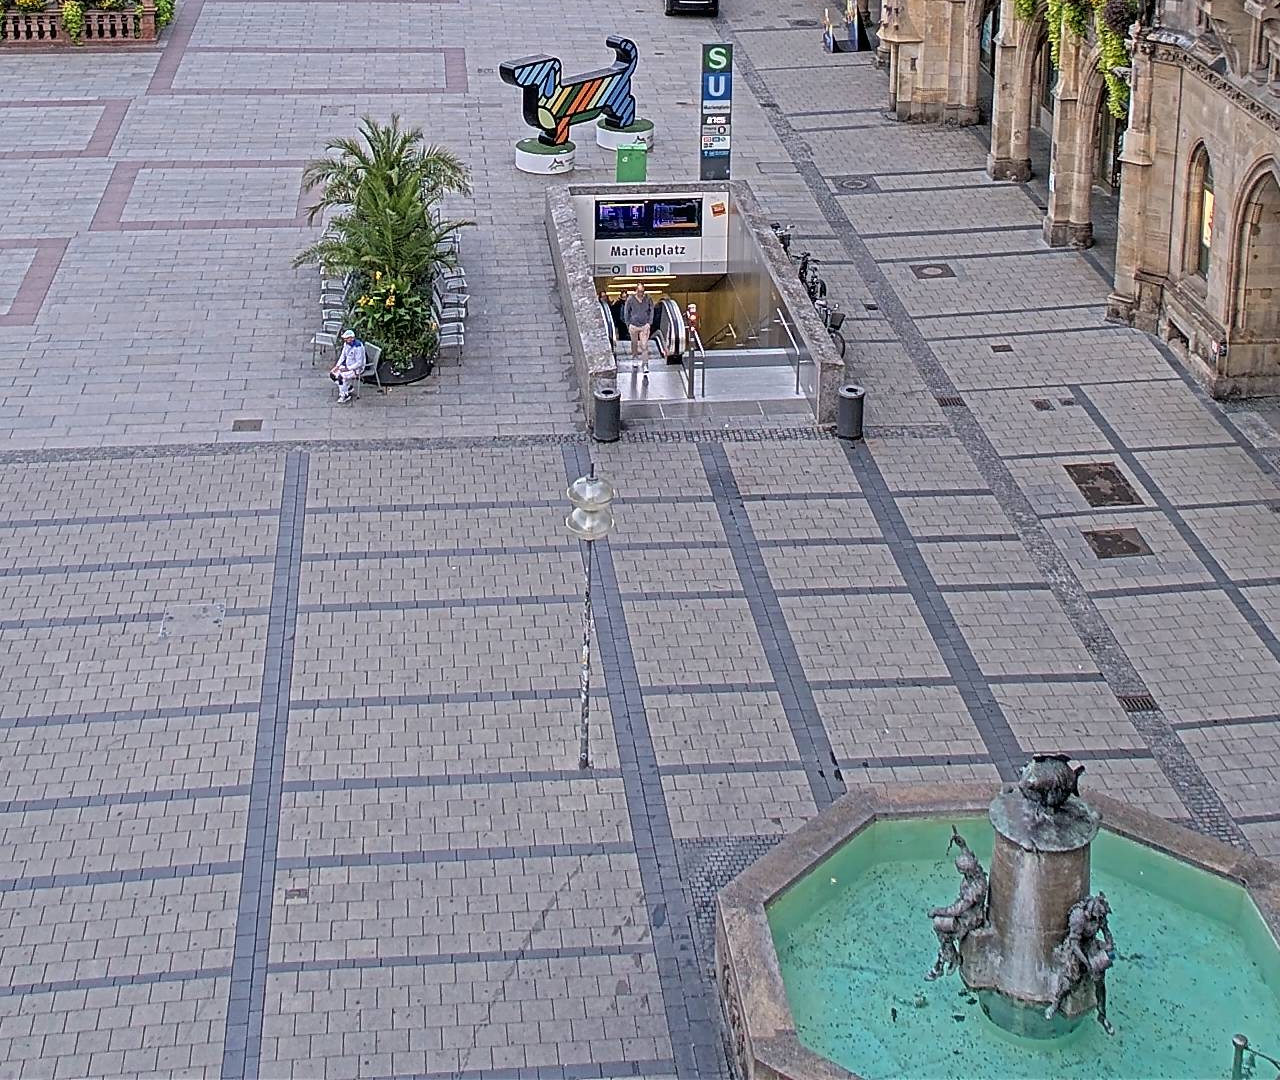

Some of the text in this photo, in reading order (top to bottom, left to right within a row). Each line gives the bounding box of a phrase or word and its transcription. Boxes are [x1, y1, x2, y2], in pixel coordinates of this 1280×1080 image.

[708, 46, 728, 70] S
[708, 75, 726, 97] U
[610, 244, 687, 258] Marienplatz
